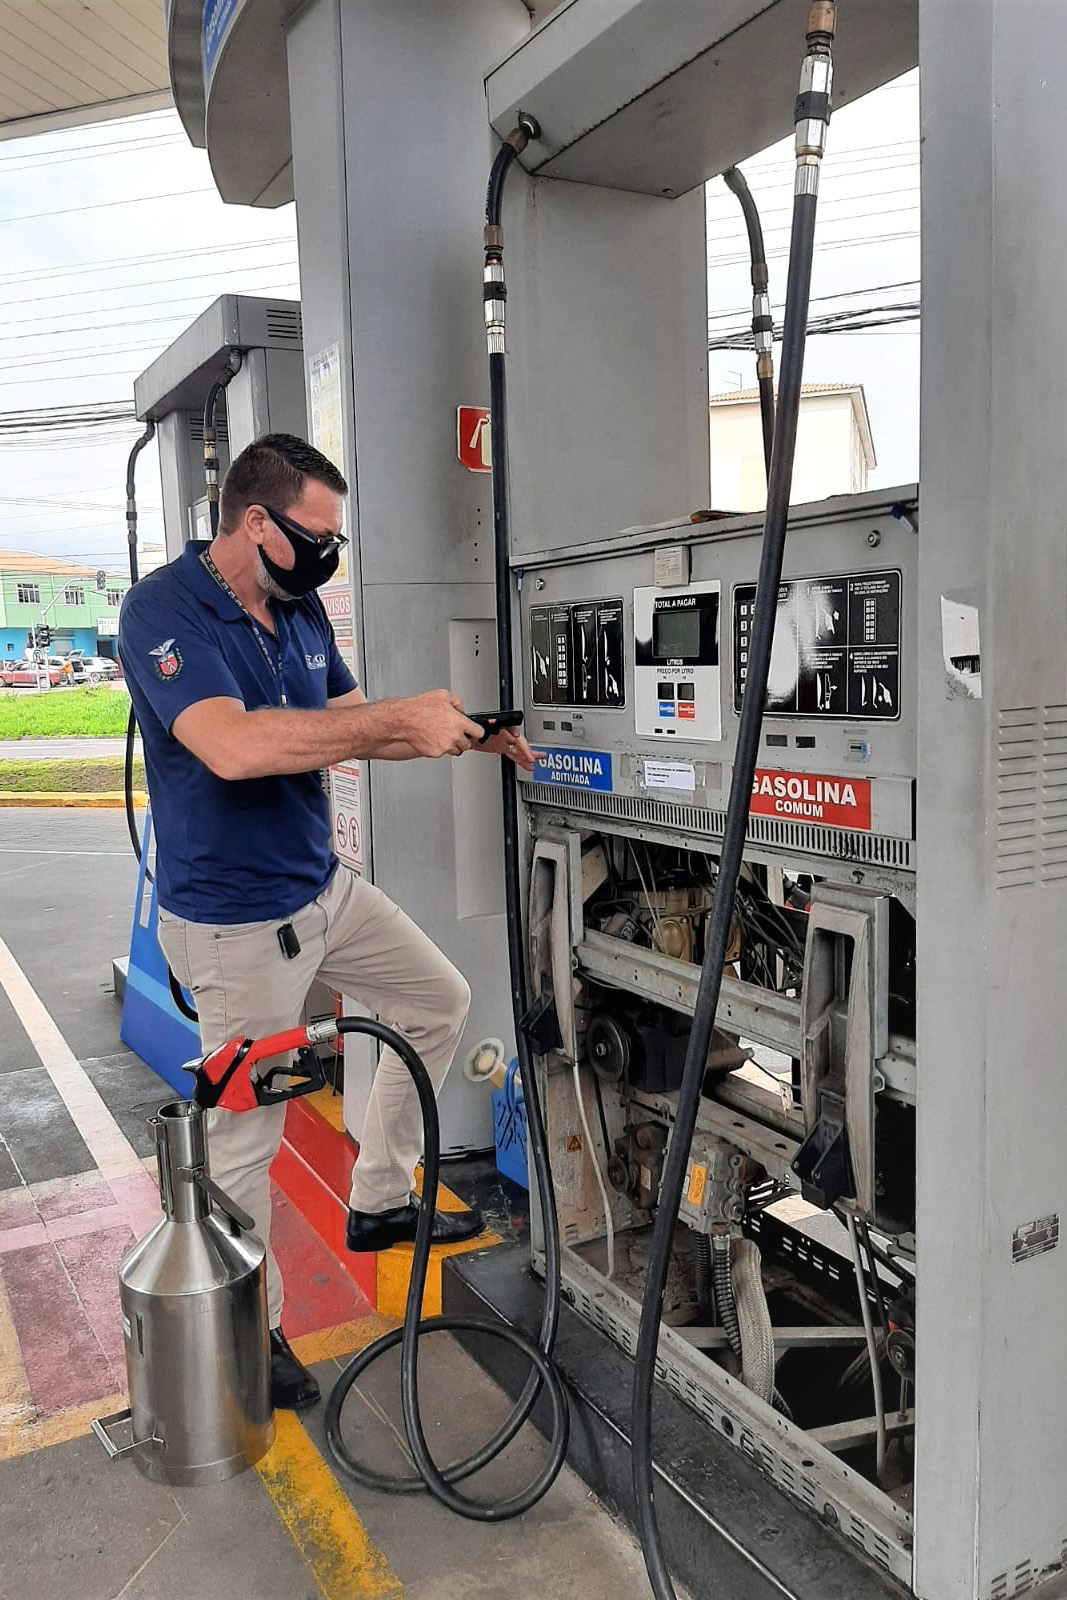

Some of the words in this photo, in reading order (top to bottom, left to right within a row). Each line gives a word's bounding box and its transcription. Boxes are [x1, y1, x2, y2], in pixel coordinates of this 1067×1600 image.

[655, 600, 671, 609] TOTAL
[671, 599, 677, 607] A
[677, 598, 696, 607] PAGAR
[539, 752, 603, 775] GASOLINA
[551, 771, 590, 786] ADITIVADA
[775, 800, 824, 818] COMUM
